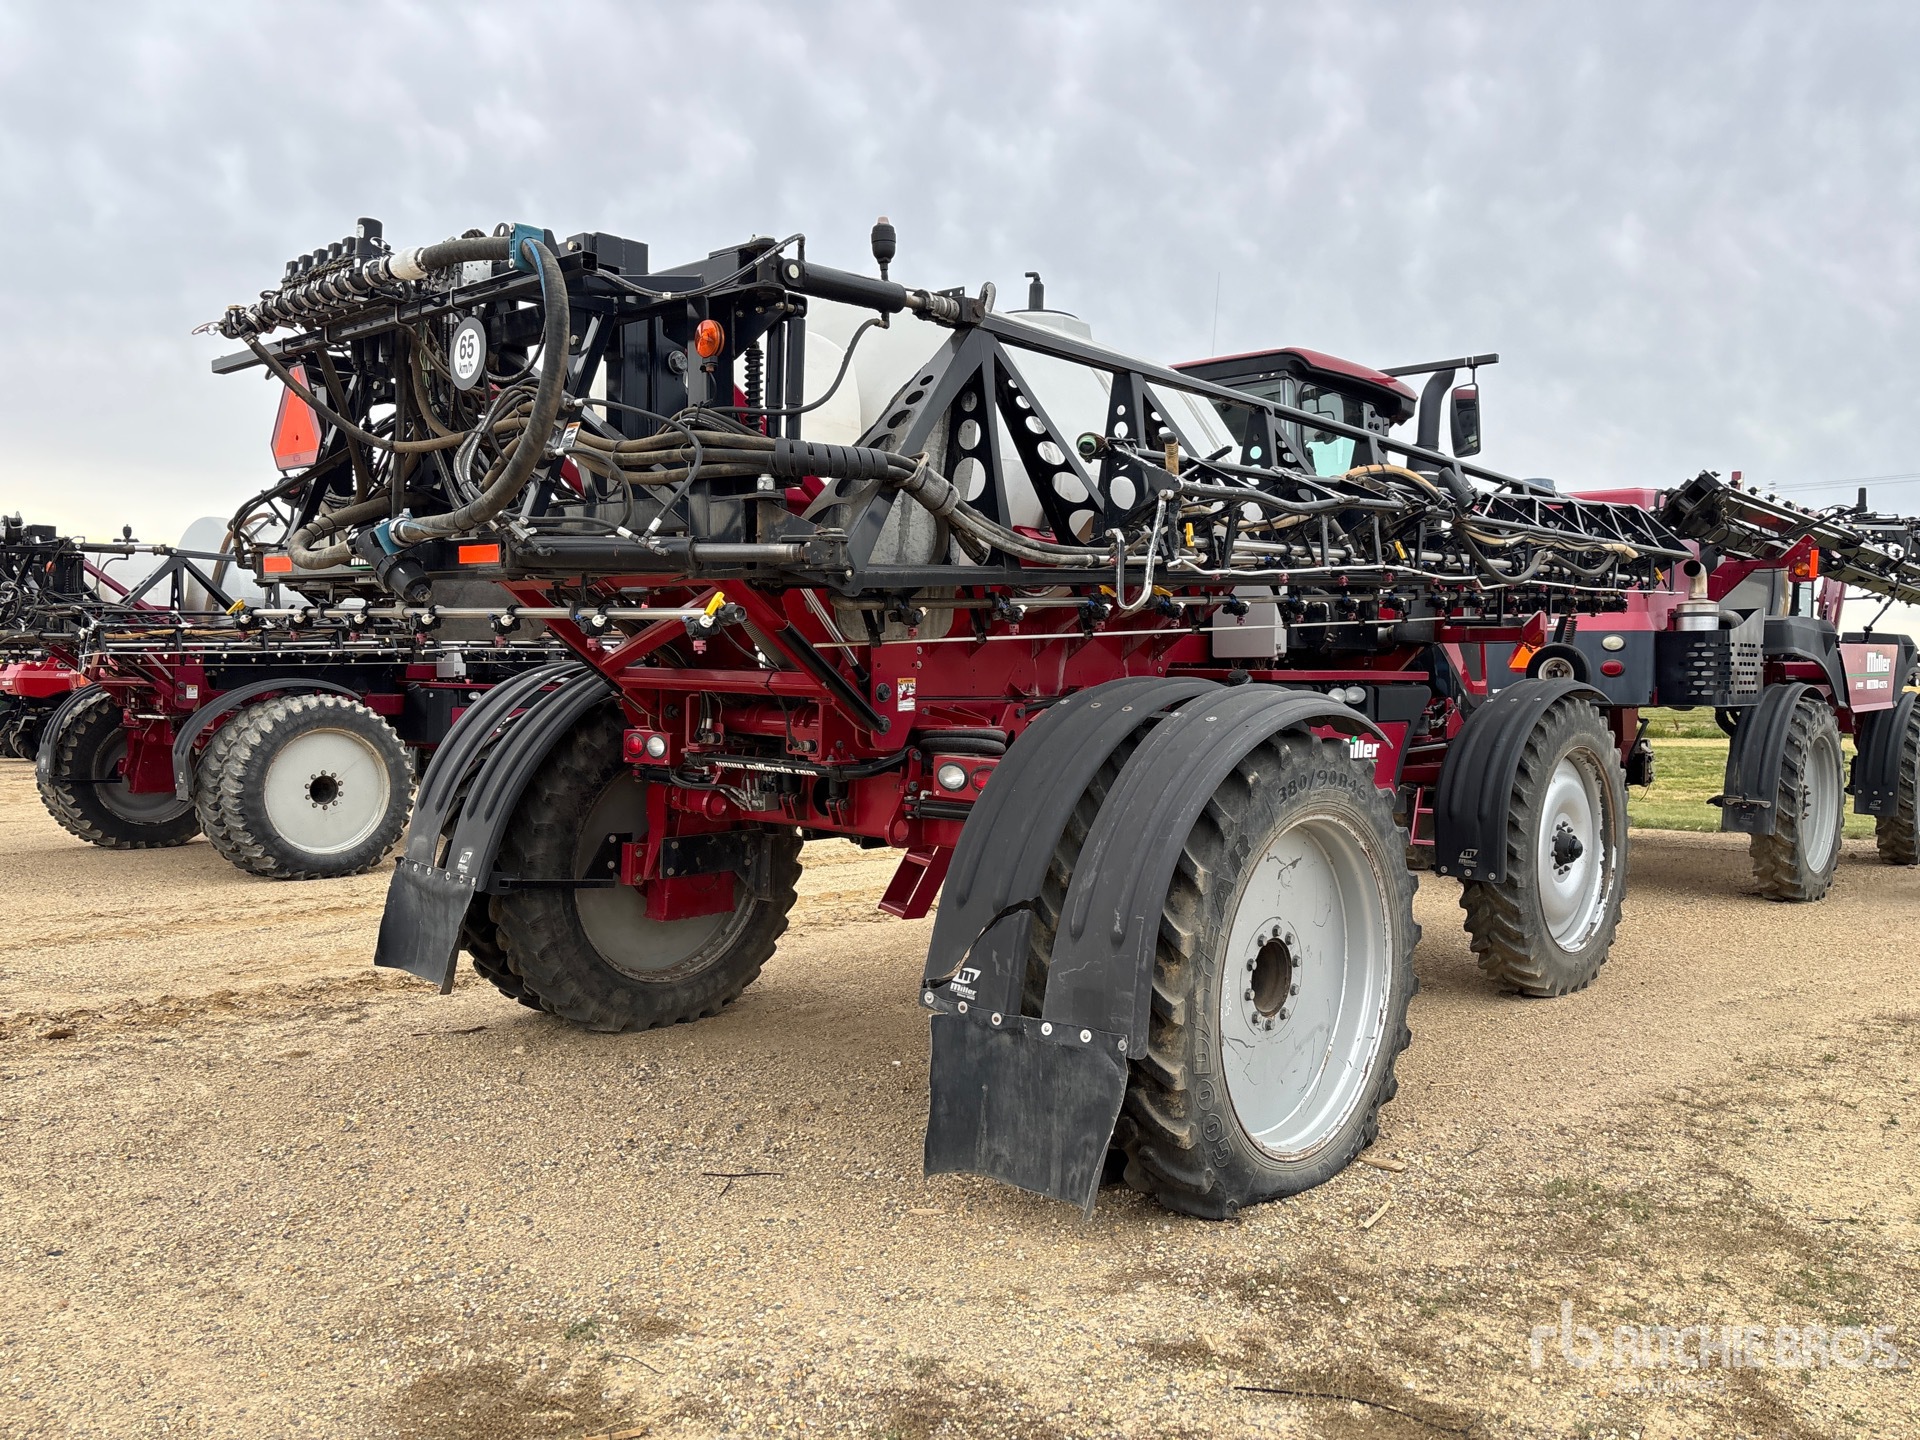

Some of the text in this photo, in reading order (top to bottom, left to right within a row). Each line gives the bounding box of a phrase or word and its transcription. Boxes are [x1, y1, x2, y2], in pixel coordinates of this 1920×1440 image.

[459, 334, 475, 360] 65
[1866, 651, 1890, 672] Miller
[1343, 735, 1380, 759] iller
[1193, 834, 1252, 1168] GOODYEAR
